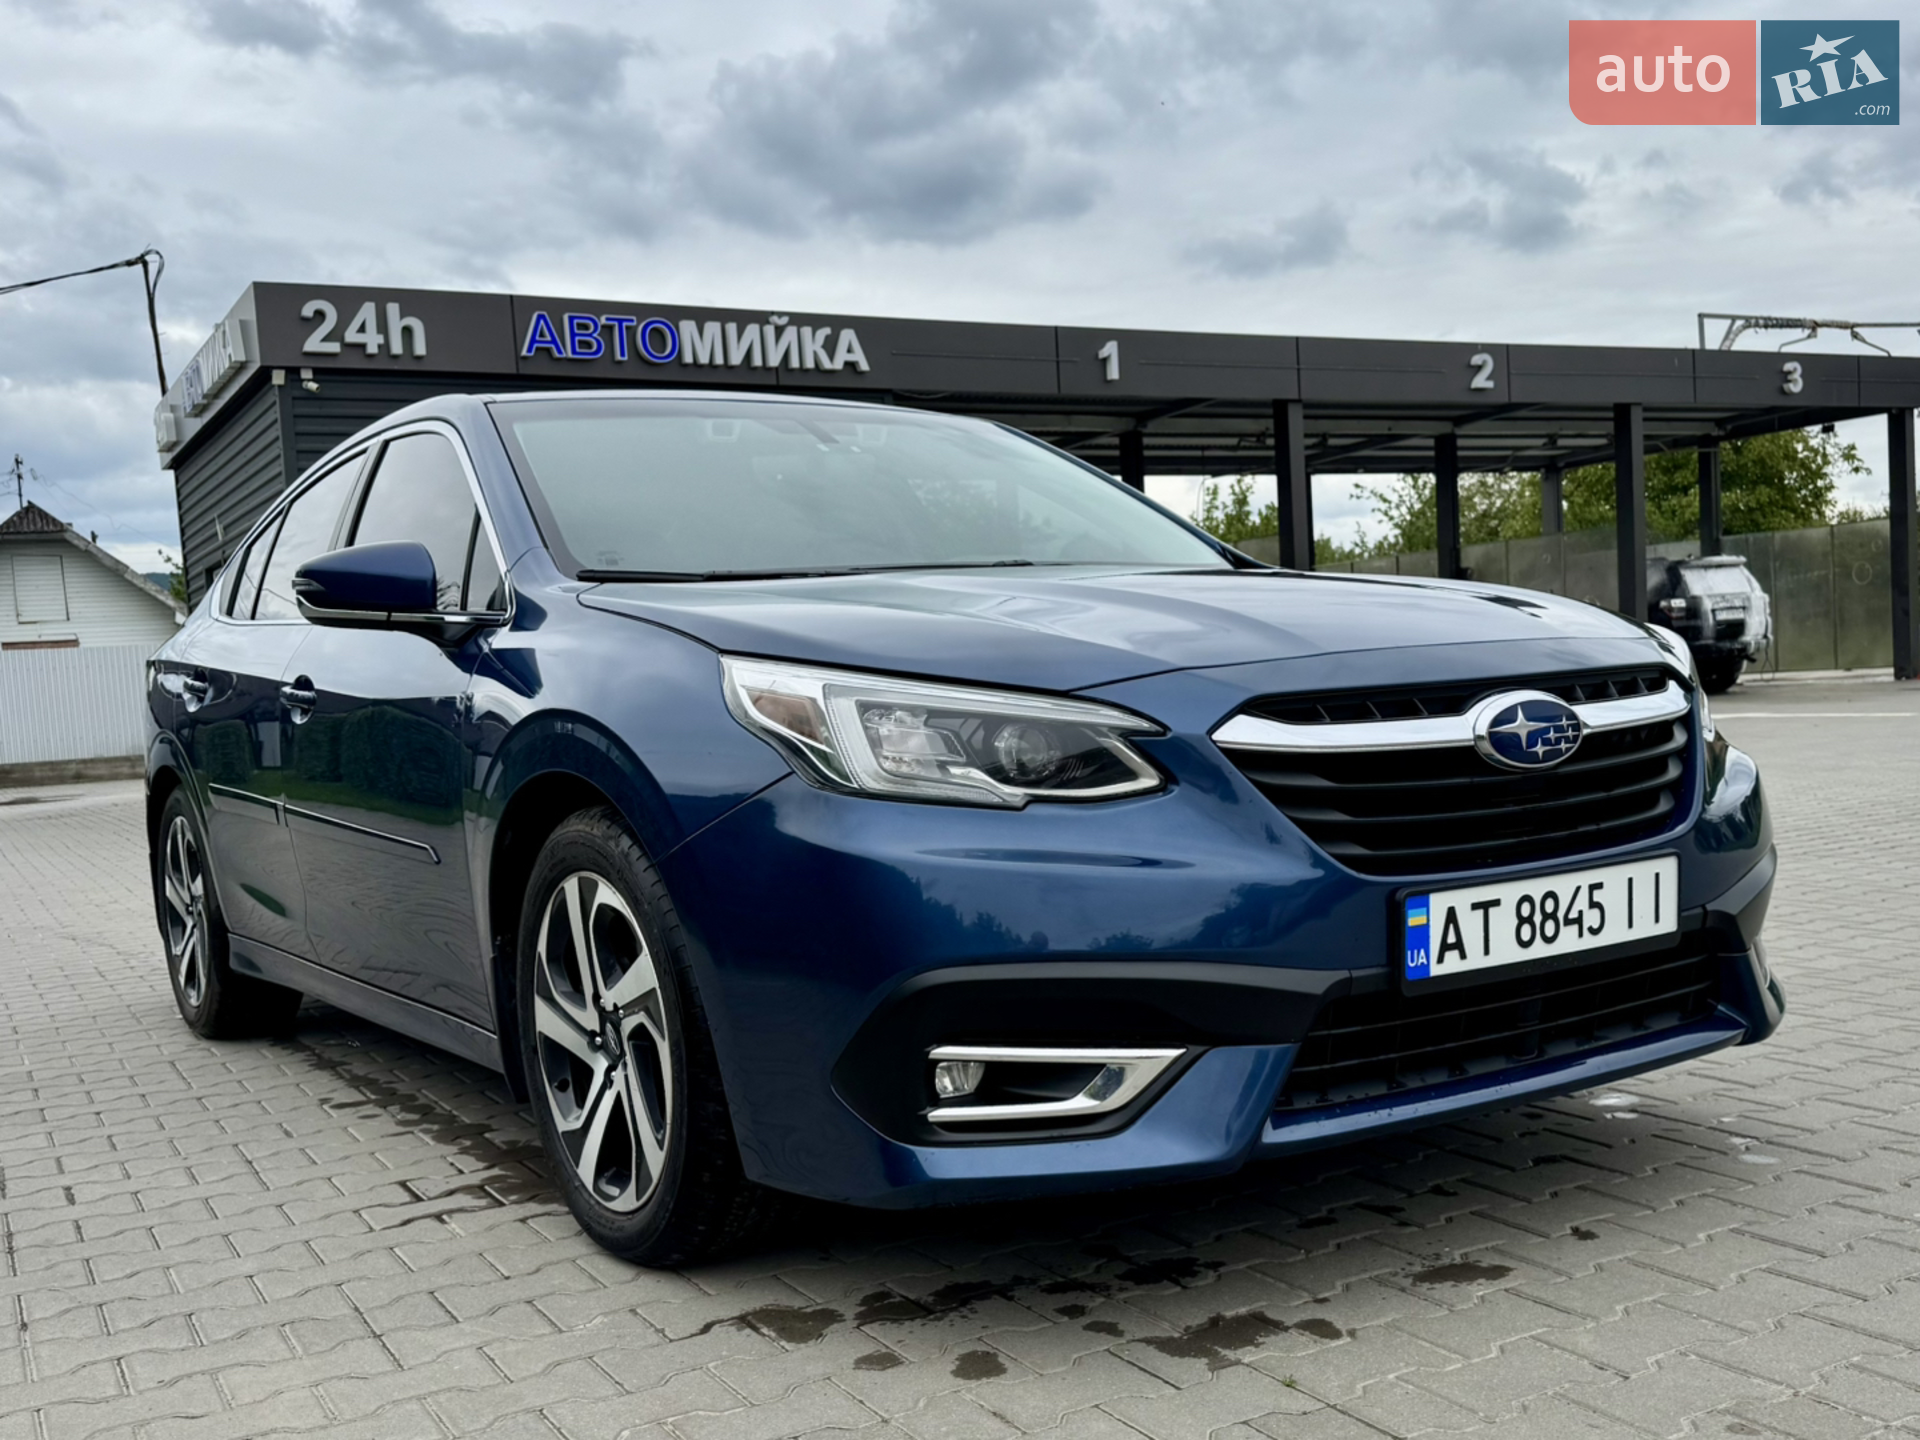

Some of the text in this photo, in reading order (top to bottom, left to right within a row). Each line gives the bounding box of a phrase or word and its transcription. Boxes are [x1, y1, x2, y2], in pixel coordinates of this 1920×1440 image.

[300, 299, 427, 358] 24h
[520, 311, 871, 373] АВТОМИЙКА
[1097, 339, 1120, 382] 1
[1469, 352, 1495, 390] 2
[1782, 361, 1804, 394] 3
[1436, 898, 1502, 965] AT
[1514, 881, 1606, 950] 8845
[1406, 948, 1428, 967] UA
